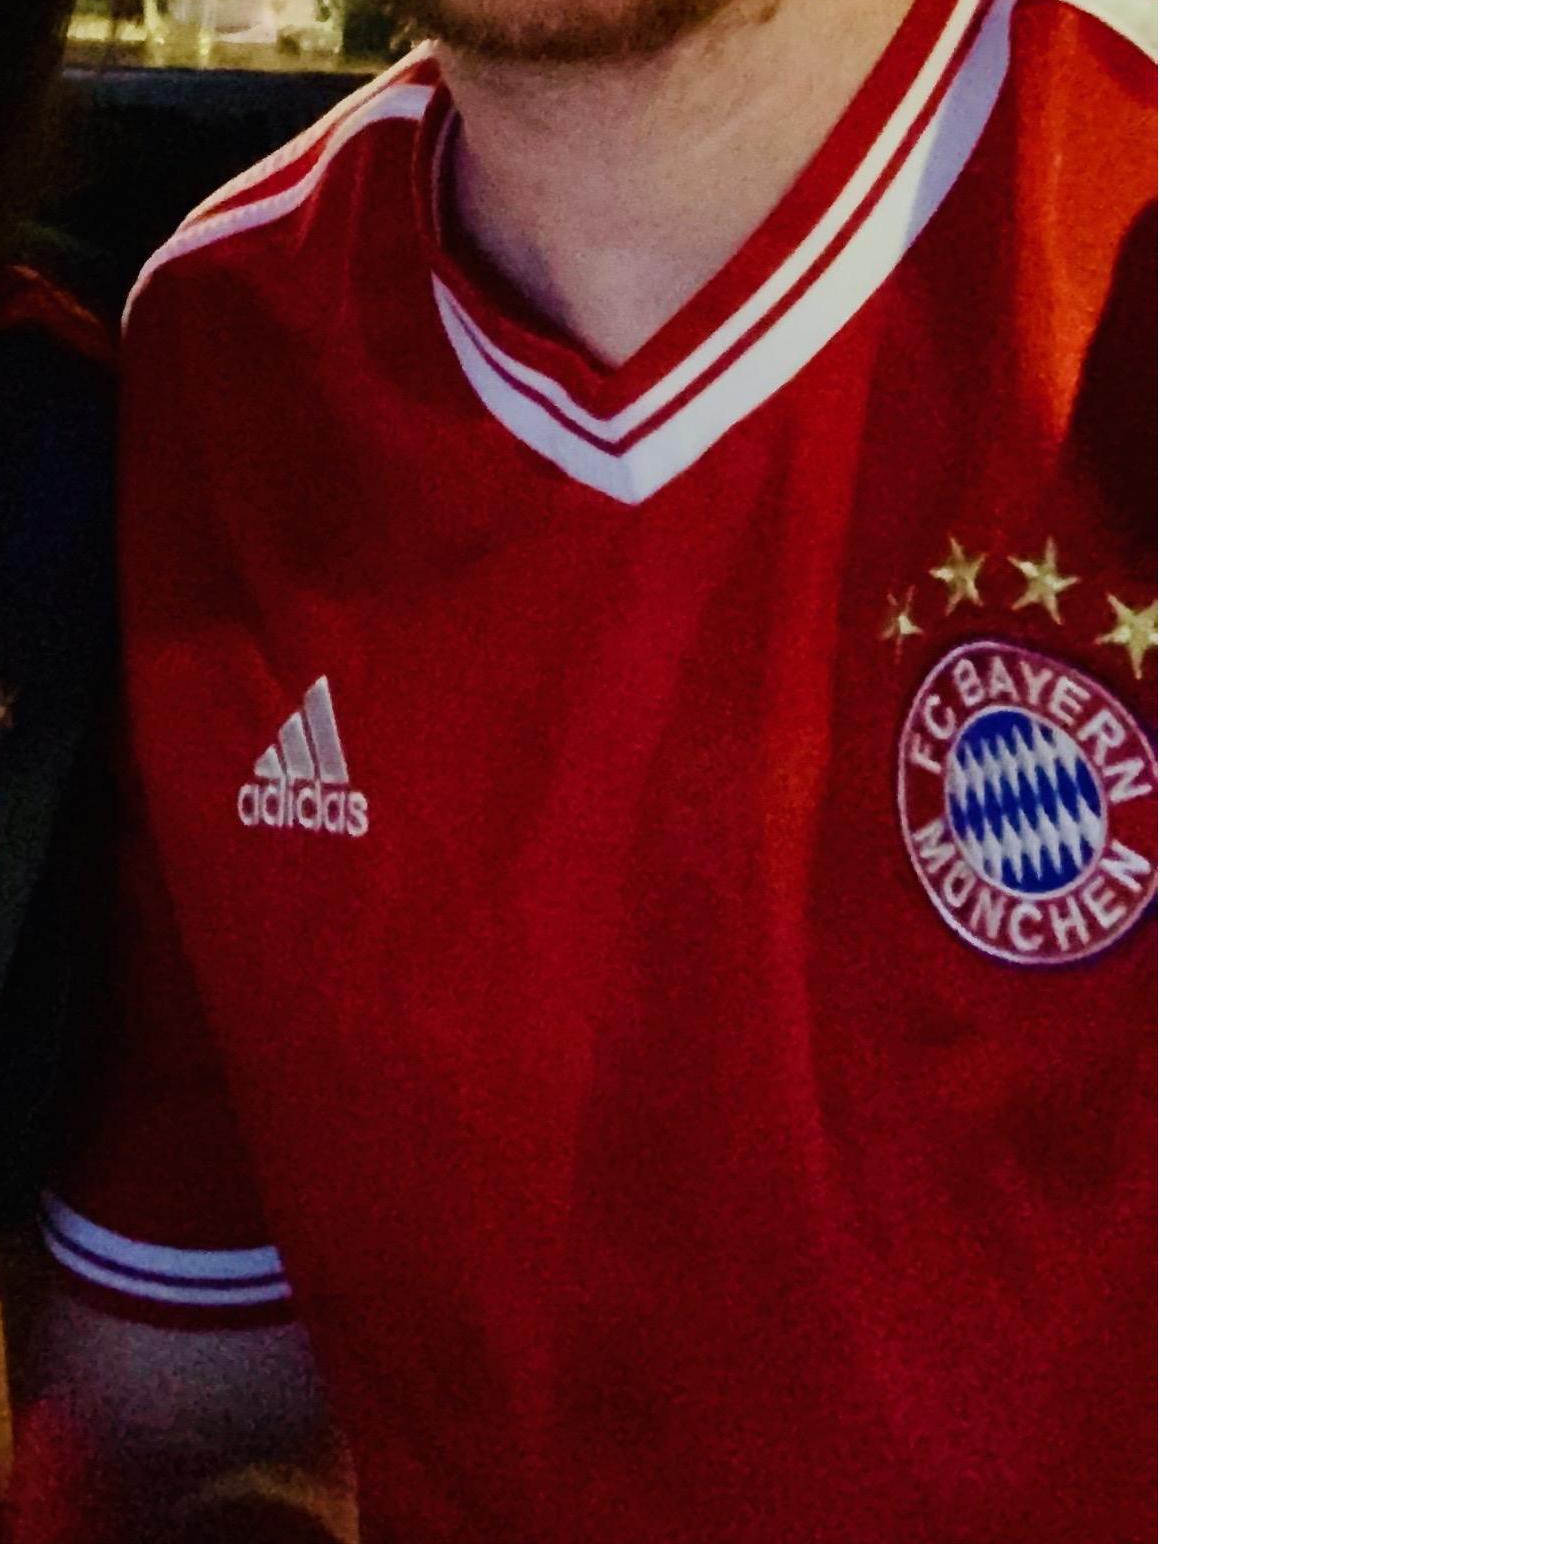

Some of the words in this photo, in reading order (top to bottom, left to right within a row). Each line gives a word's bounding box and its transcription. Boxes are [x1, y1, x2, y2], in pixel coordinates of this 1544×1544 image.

[911, 695, 955, 775] FC
[953, 656, 1153, 804] BAYERN
[237, 773, 369, 837] adidas
